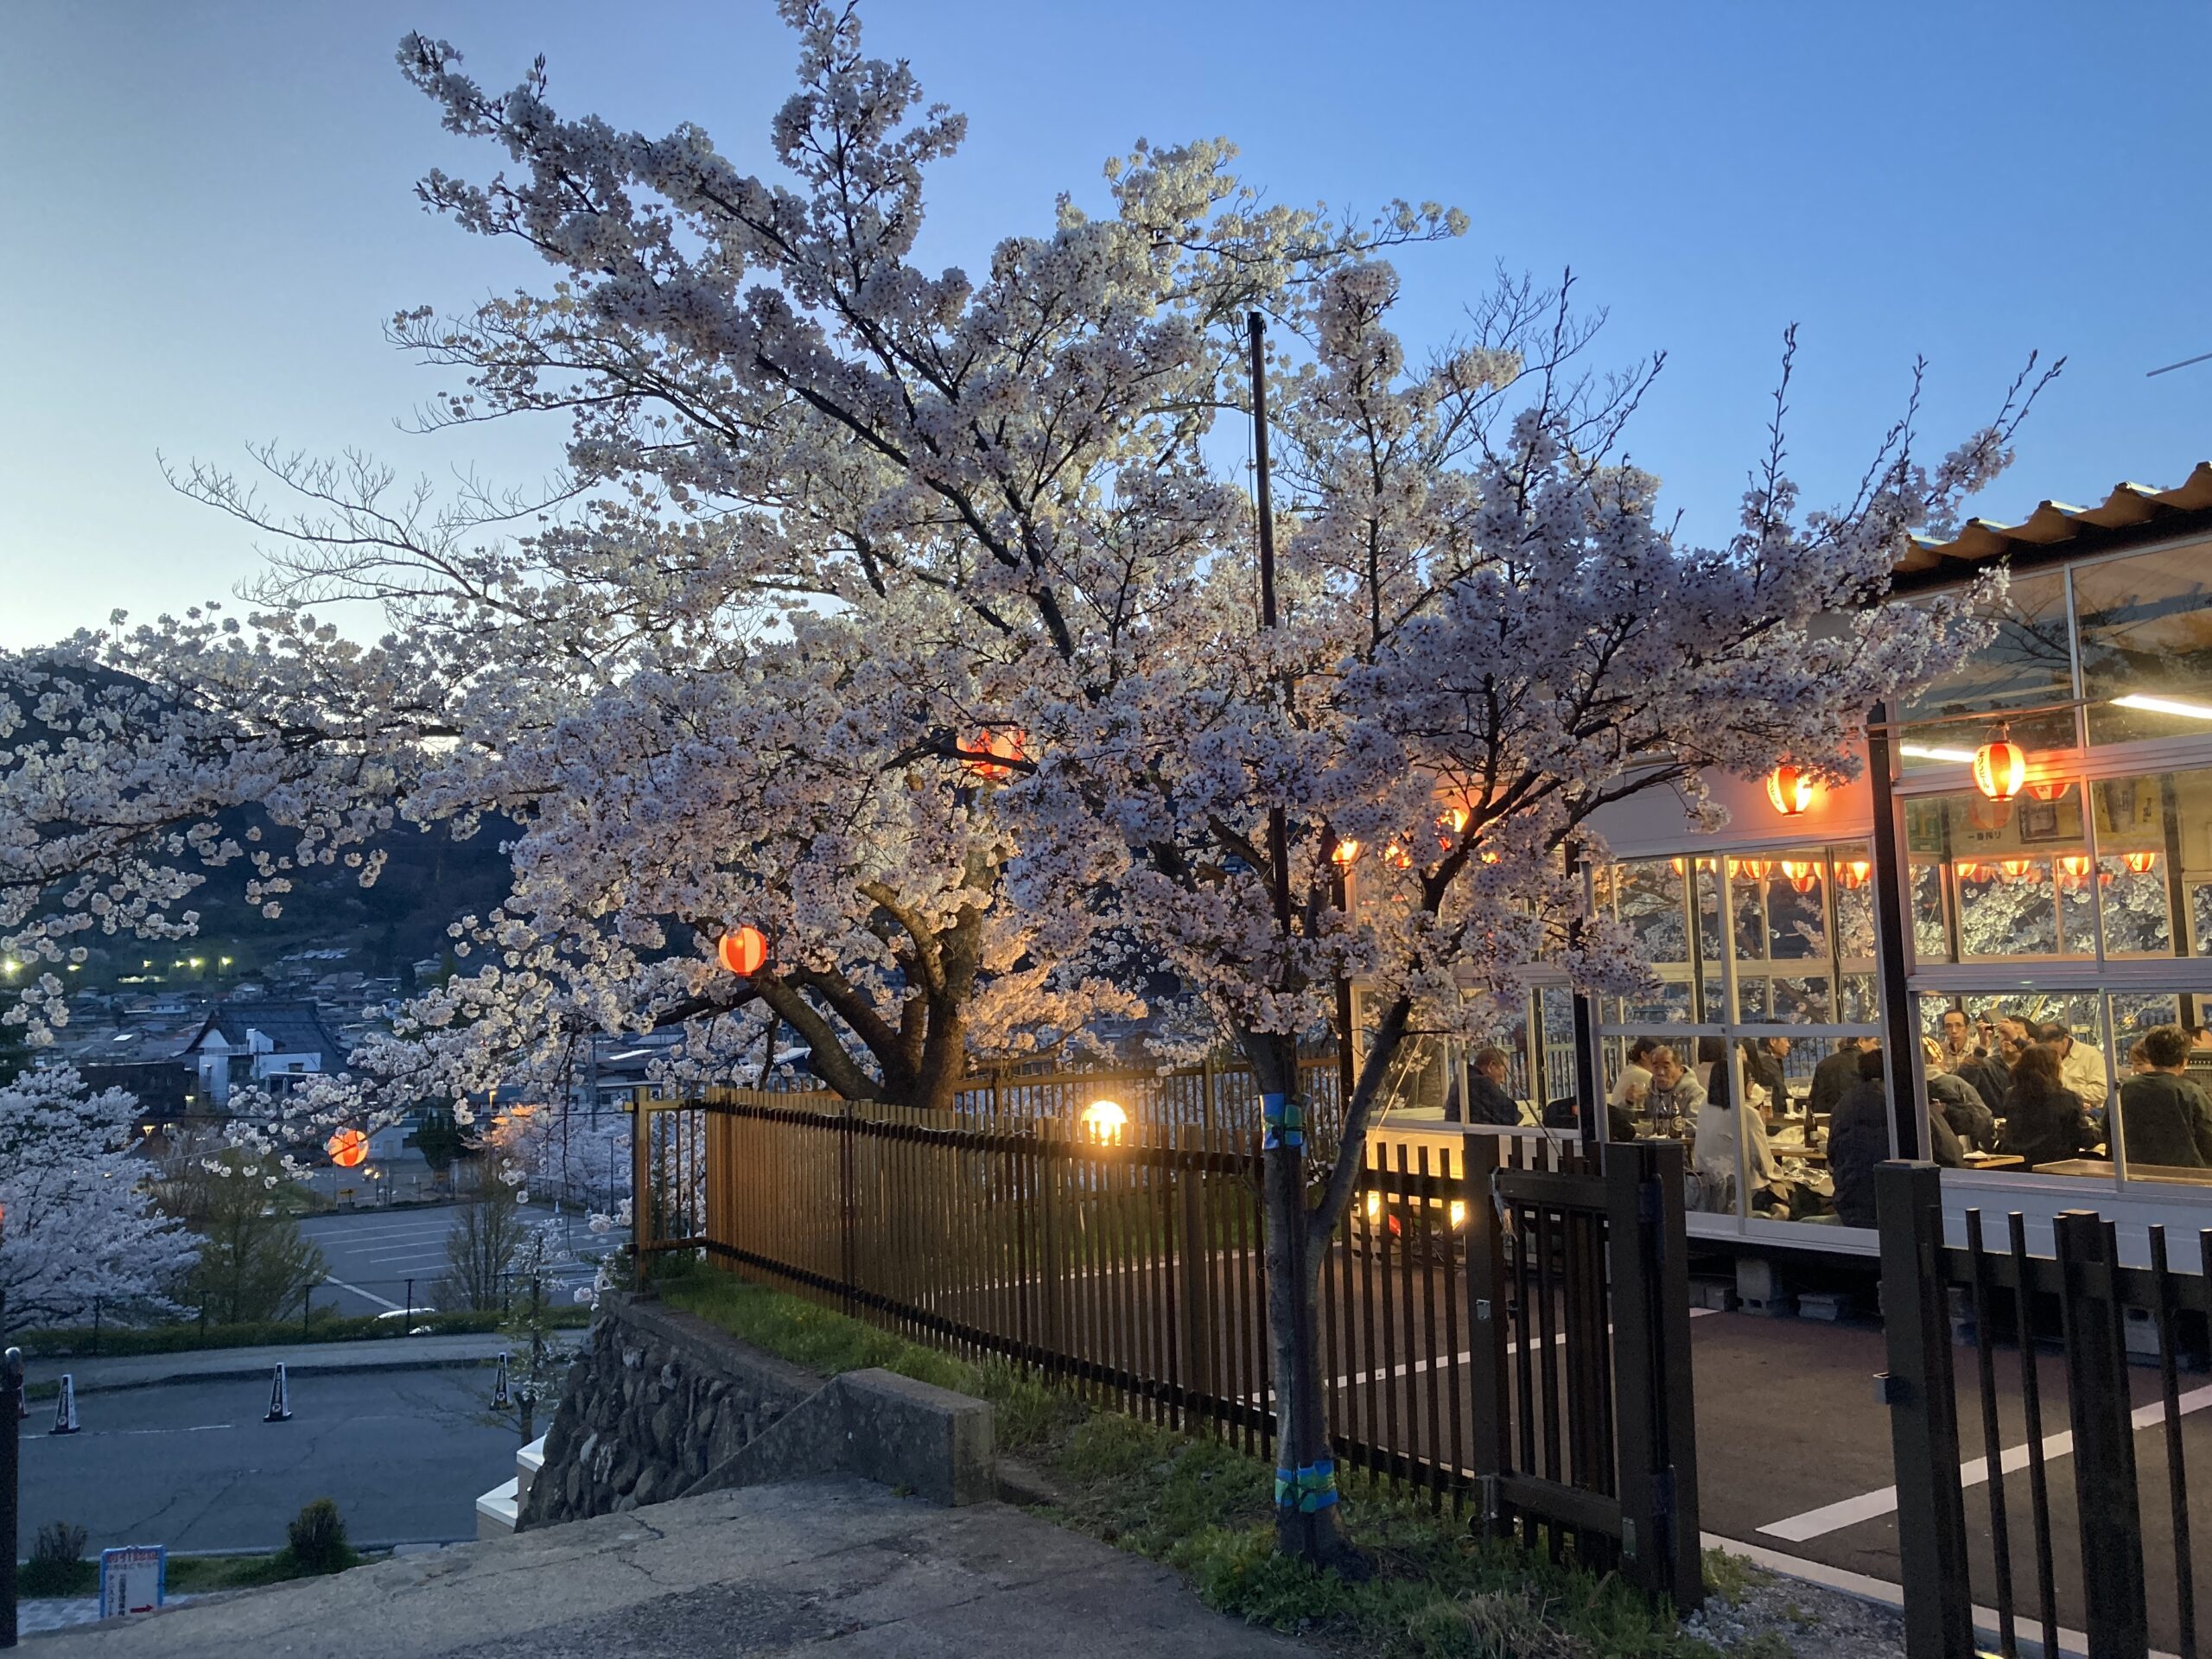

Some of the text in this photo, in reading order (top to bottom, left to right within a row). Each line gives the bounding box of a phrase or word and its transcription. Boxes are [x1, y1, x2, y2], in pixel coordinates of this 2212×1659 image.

[1977, 751, 1989, 788] キリンビール
